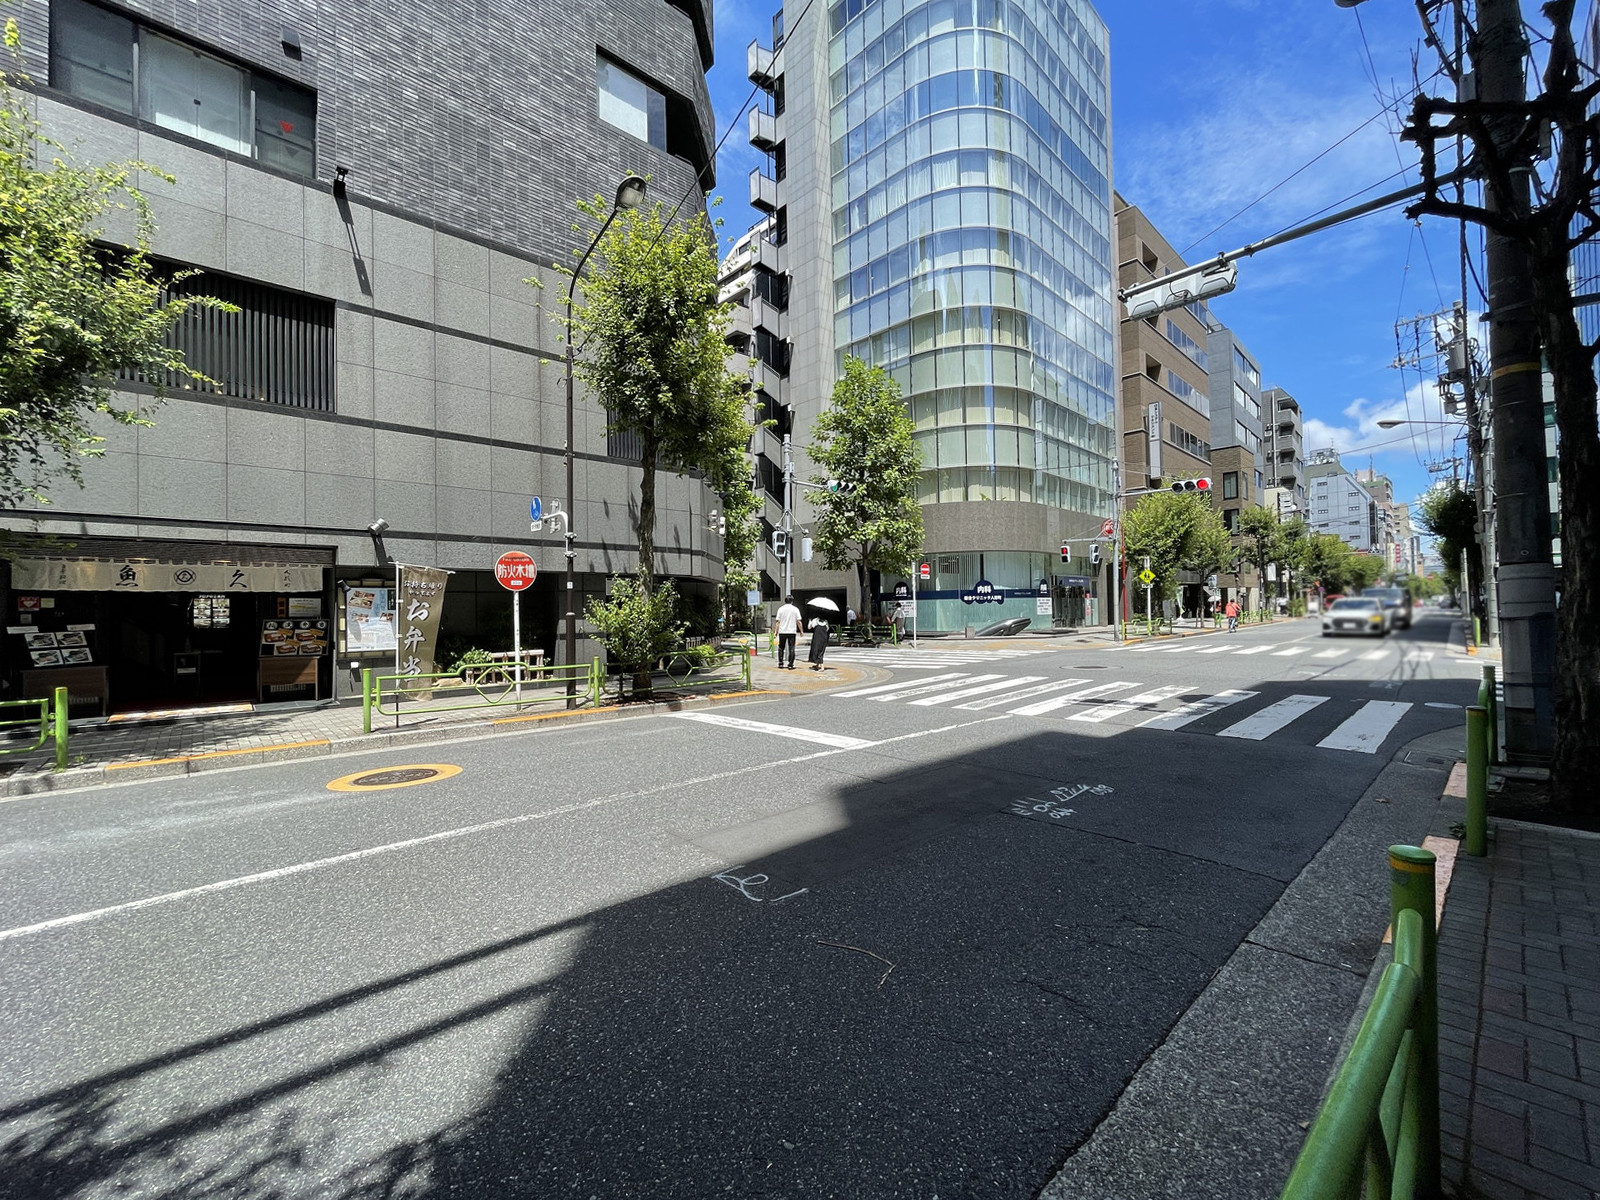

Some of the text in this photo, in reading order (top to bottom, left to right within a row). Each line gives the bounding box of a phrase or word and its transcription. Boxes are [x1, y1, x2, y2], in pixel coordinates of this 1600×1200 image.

[115, 564, 248, 588] 魚 久
[977, 585, 992, 594] 内科
